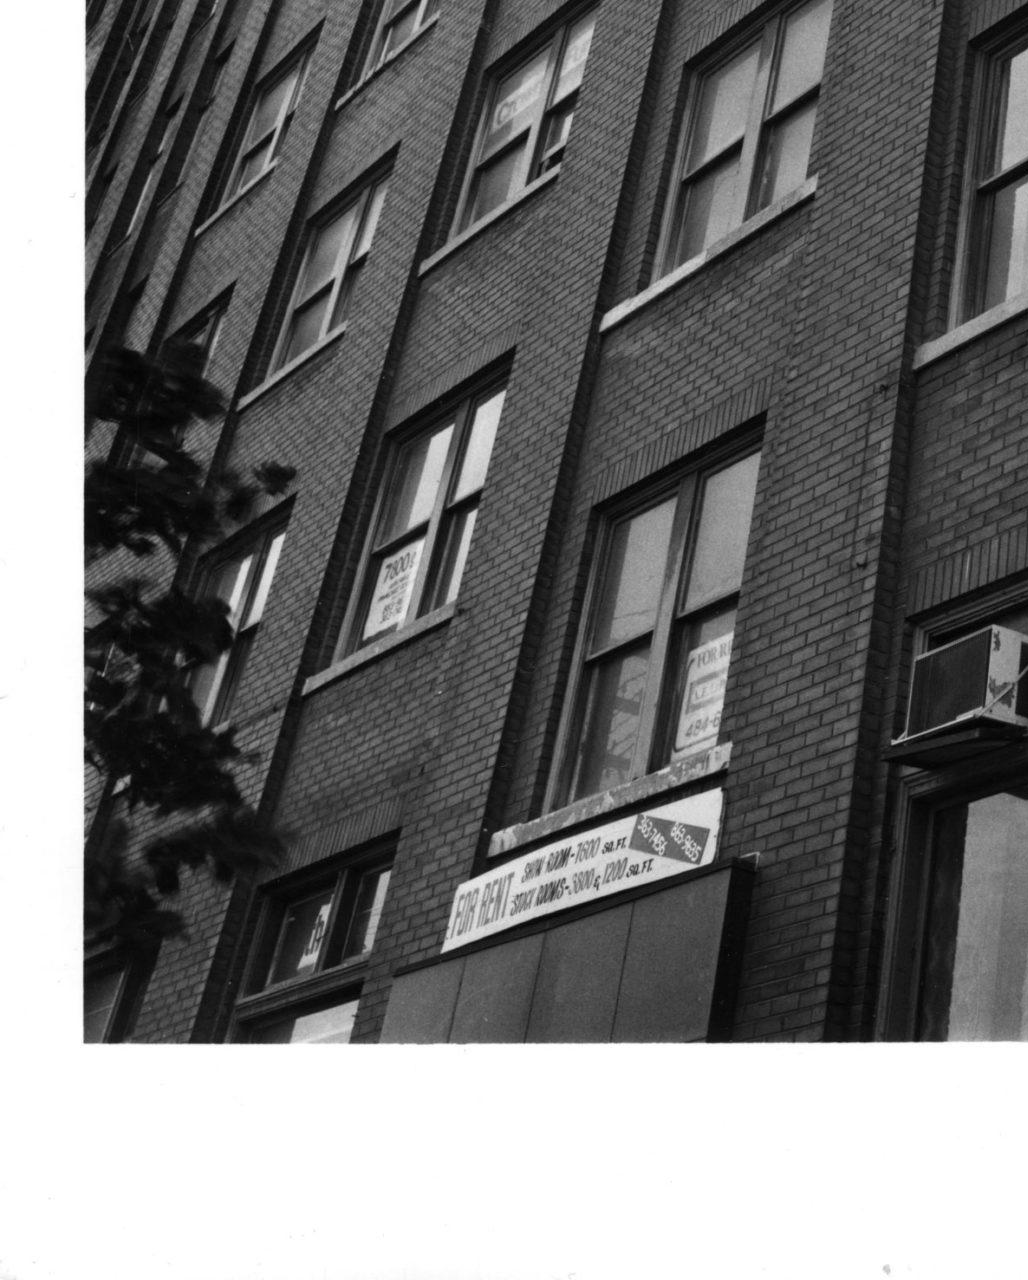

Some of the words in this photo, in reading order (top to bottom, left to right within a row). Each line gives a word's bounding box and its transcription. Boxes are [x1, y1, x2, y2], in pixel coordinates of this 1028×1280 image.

[601, 857, 628, 885] 1200
[449, 887, 480, 940] FOR
[476, 872, 515, 929] RENT
